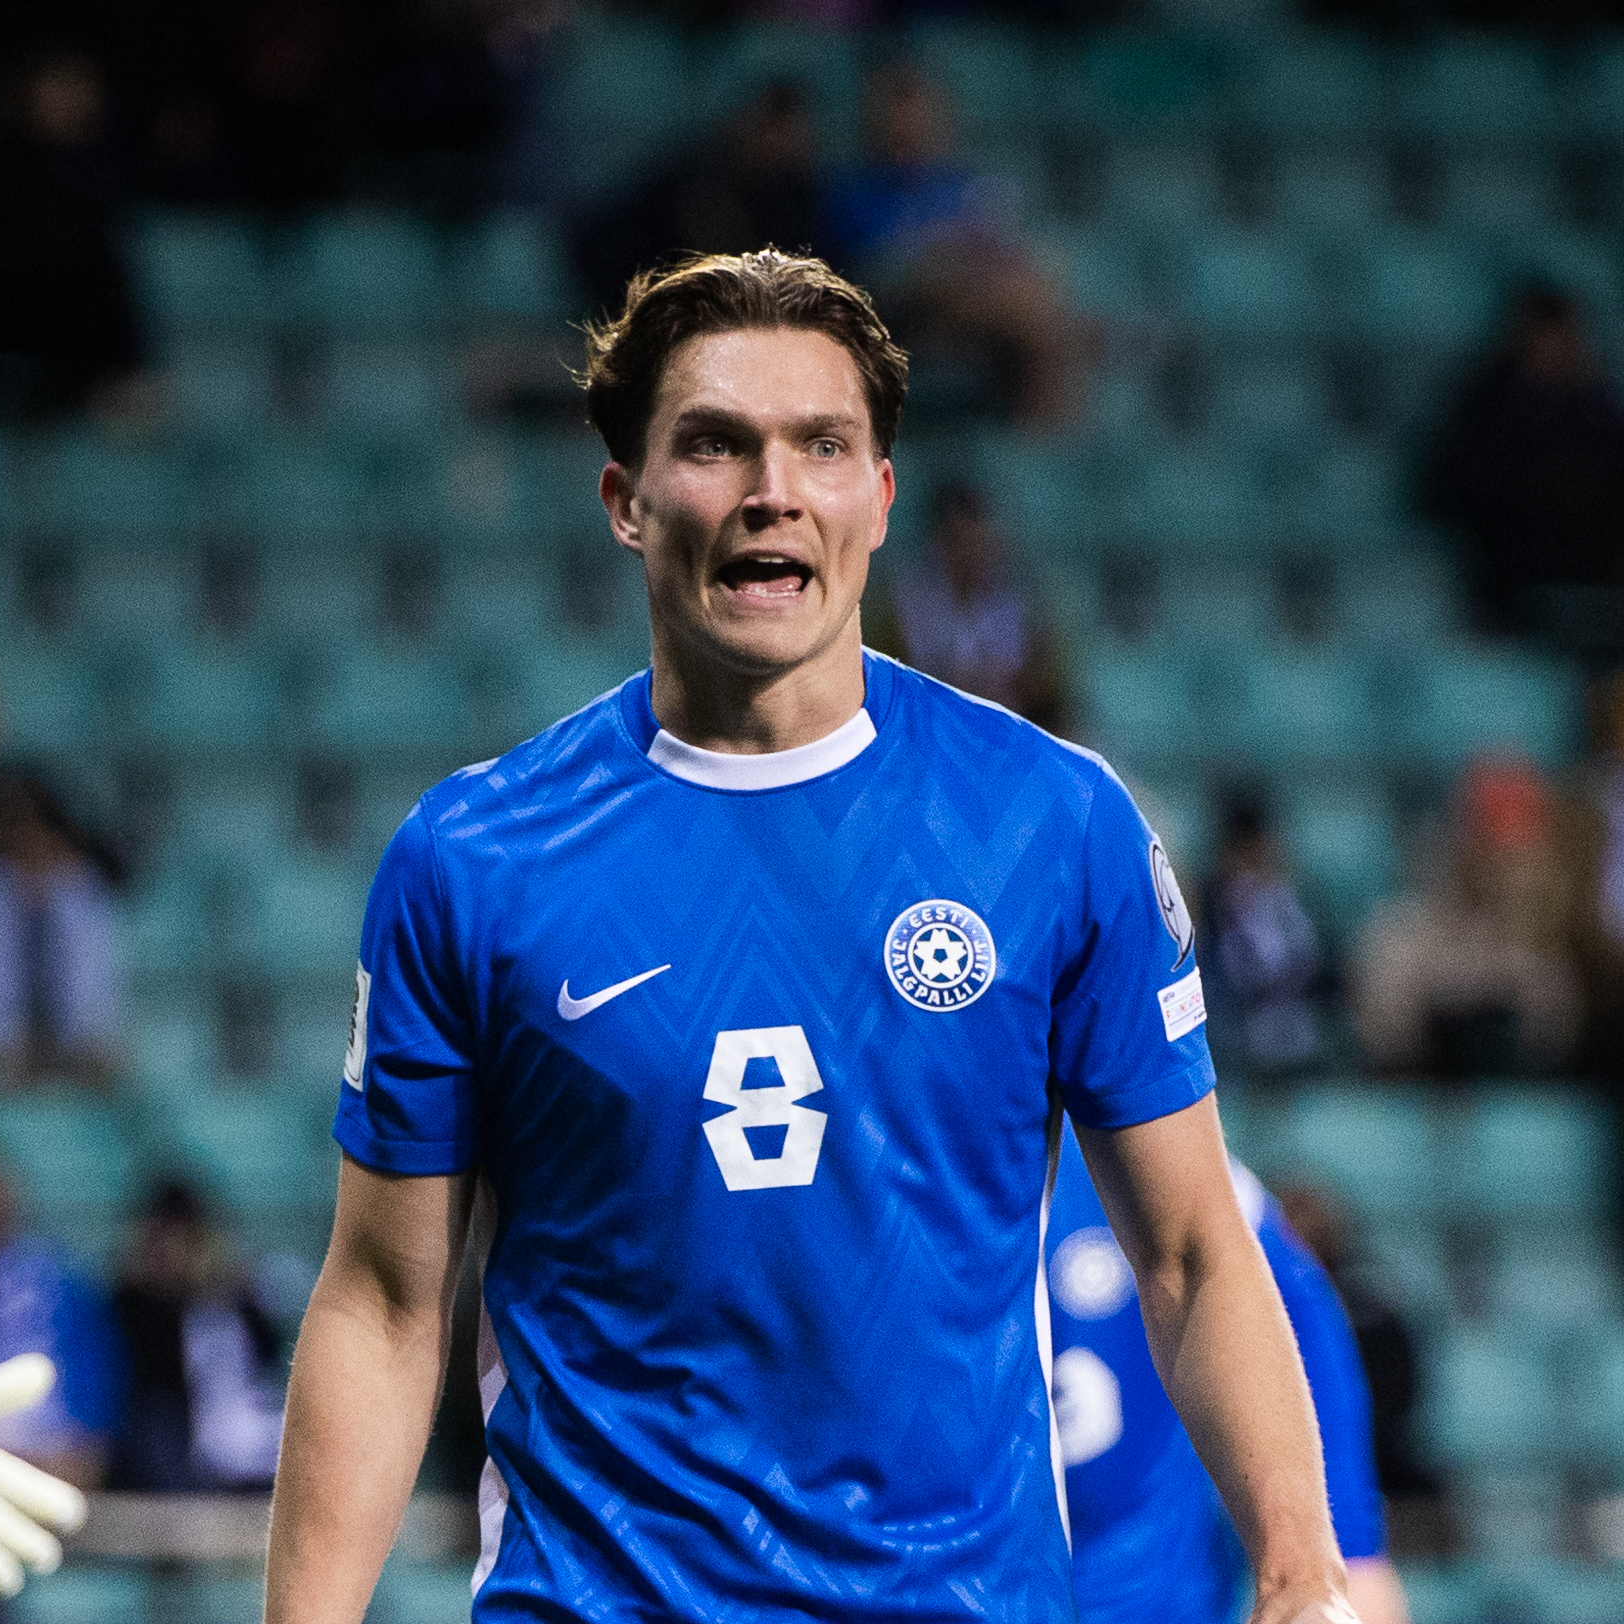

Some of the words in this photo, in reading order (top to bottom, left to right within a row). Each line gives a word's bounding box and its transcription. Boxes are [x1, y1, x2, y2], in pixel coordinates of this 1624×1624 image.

[908, 906, 970, 928] EESTI
[891, 938, 975, 1005] JALGPALLI
[970, 940, 990, 983] LIIT
[701, 1025, 829, 1192] 8
